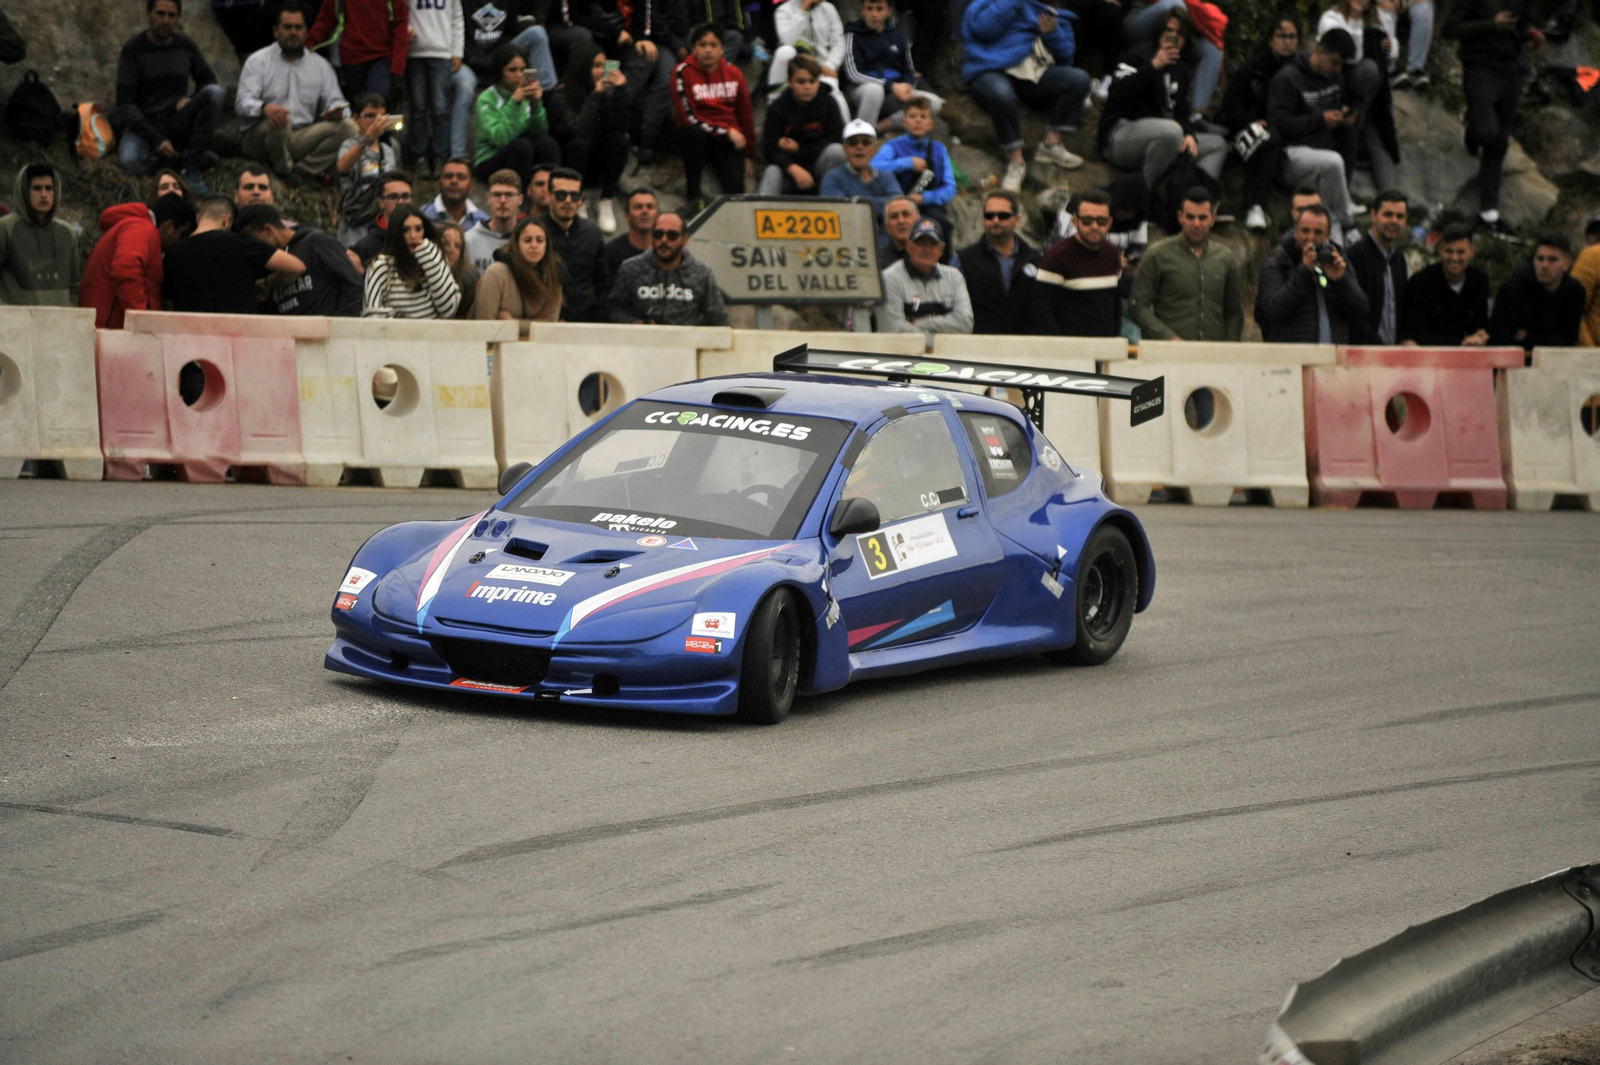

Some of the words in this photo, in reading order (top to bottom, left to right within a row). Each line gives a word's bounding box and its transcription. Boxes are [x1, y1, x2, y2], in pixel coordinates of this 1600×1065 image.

[763, 215, 837, 234] A-2201
[731, 246, 787, 267] SAN
[802, 247, 869, 268] JOSE
[637, 283, 694, 301] adidas
[748, 275, 788, 291] DEL
[798, 275, 859, 291] VALLE
[644, 411, 812, 441] CCRACING.ES
[590, 512, 678, 529] pakelo
[629, 526, 667, 535] RICANTS
[868, 537, 887, 571] 3
[500, 565, 565, 578] LANDAJO
